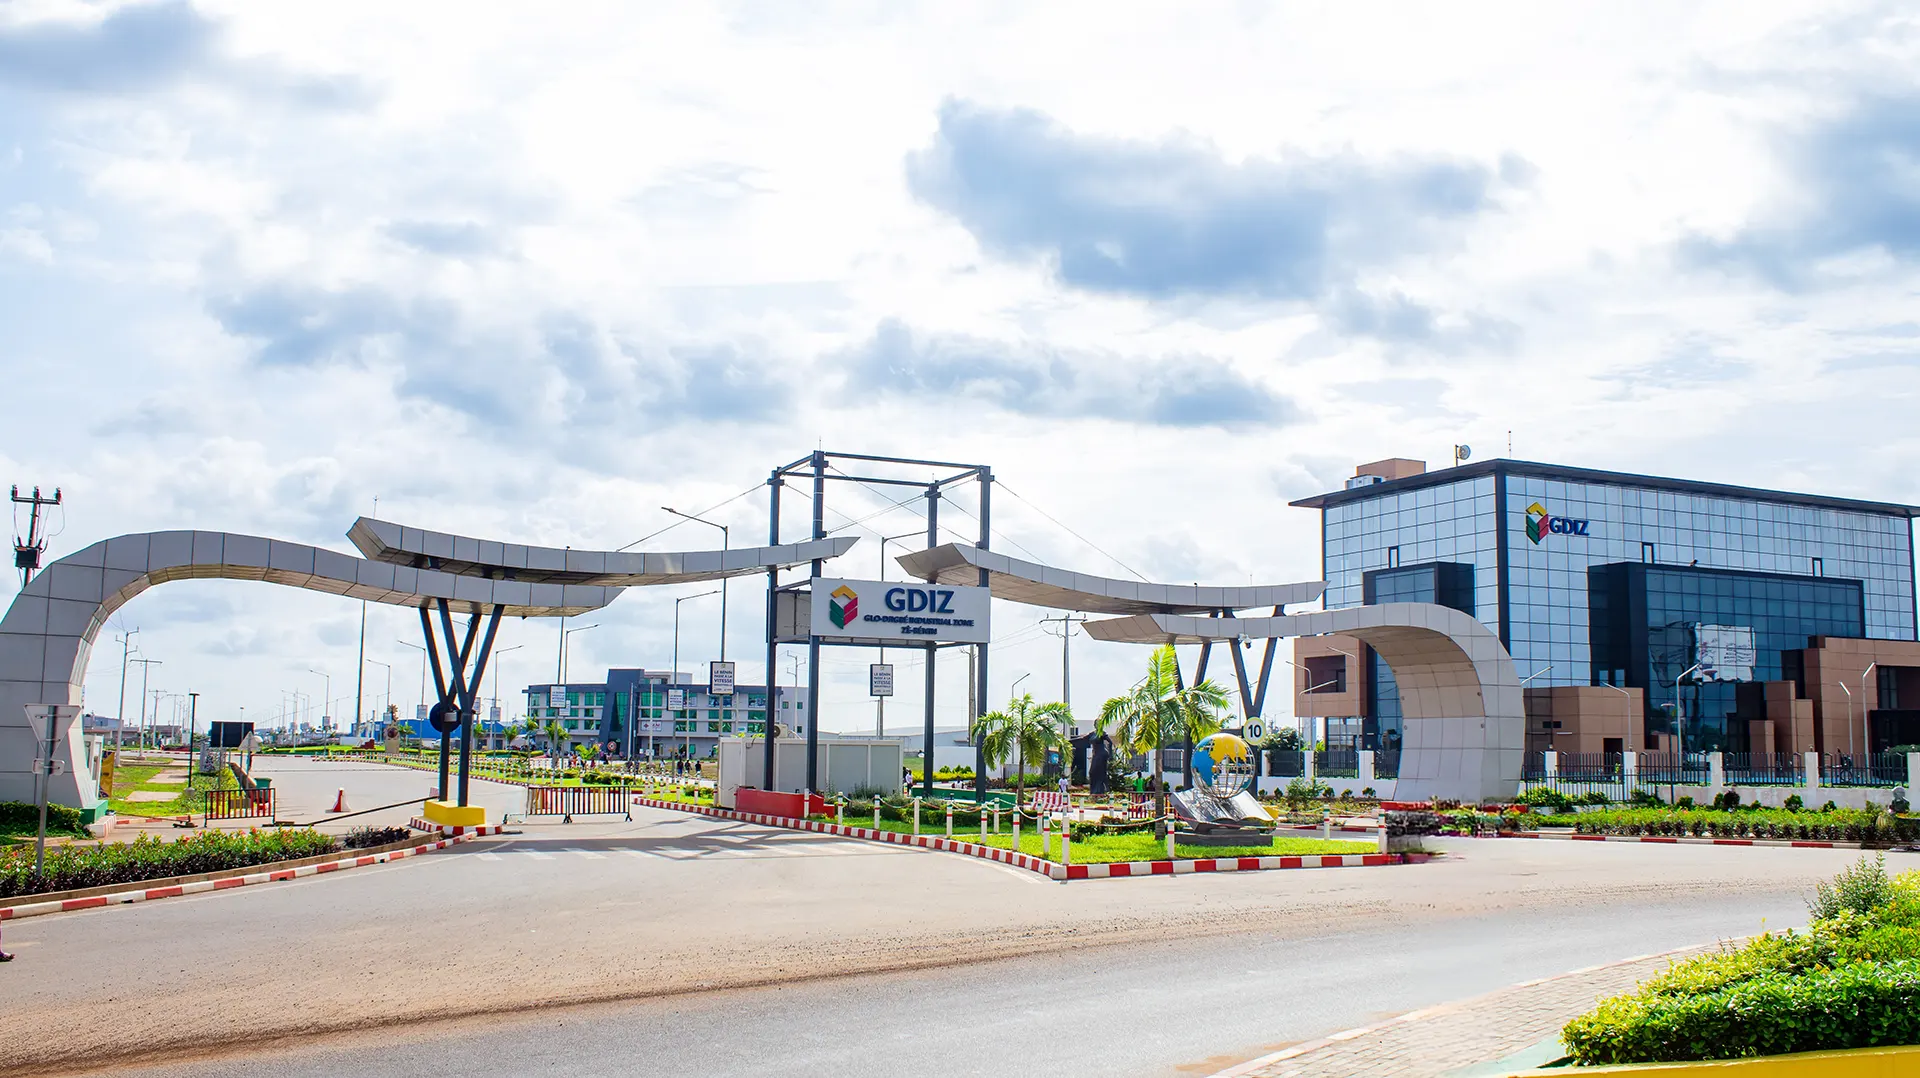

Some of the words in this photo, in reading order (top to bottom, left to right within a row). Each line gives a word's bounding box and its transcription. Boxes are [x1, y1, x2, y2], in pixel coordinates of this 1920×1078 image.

[1549, 517, 1590, 536] GDIZ
[885, 587, 955, 614] GDIZ
[909, 617, 952, 626] INDUSTRIAL
[952, 619, 974, 627] ZONE
[1248, 724, 1261, 738] 10
